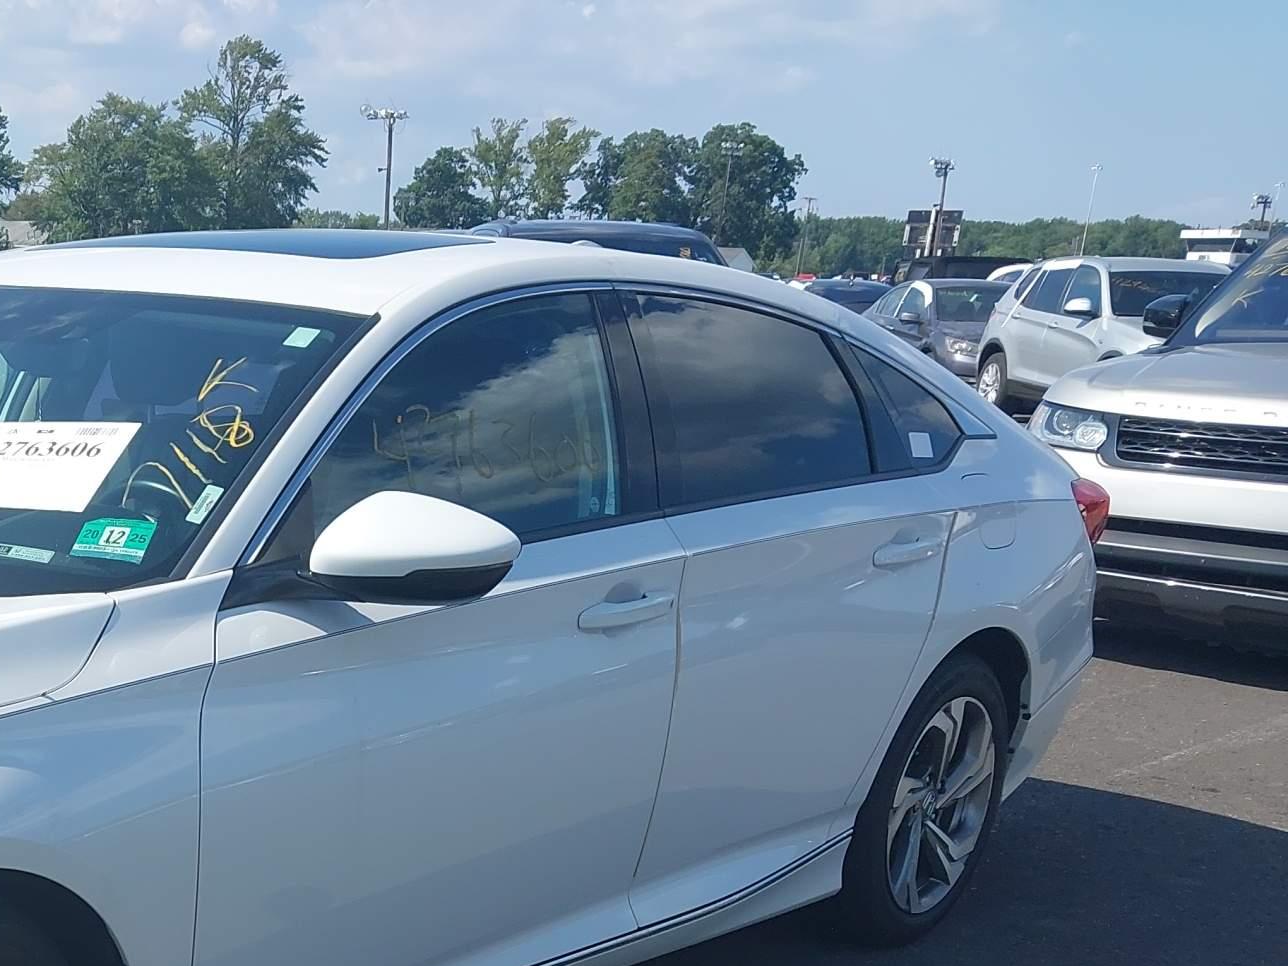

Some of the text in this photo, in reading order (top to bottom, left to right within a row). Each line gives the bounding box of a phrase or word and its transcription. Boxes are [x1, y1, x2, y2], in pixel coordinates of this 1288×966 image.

[83, 528, 148, 545] 20 12 25
